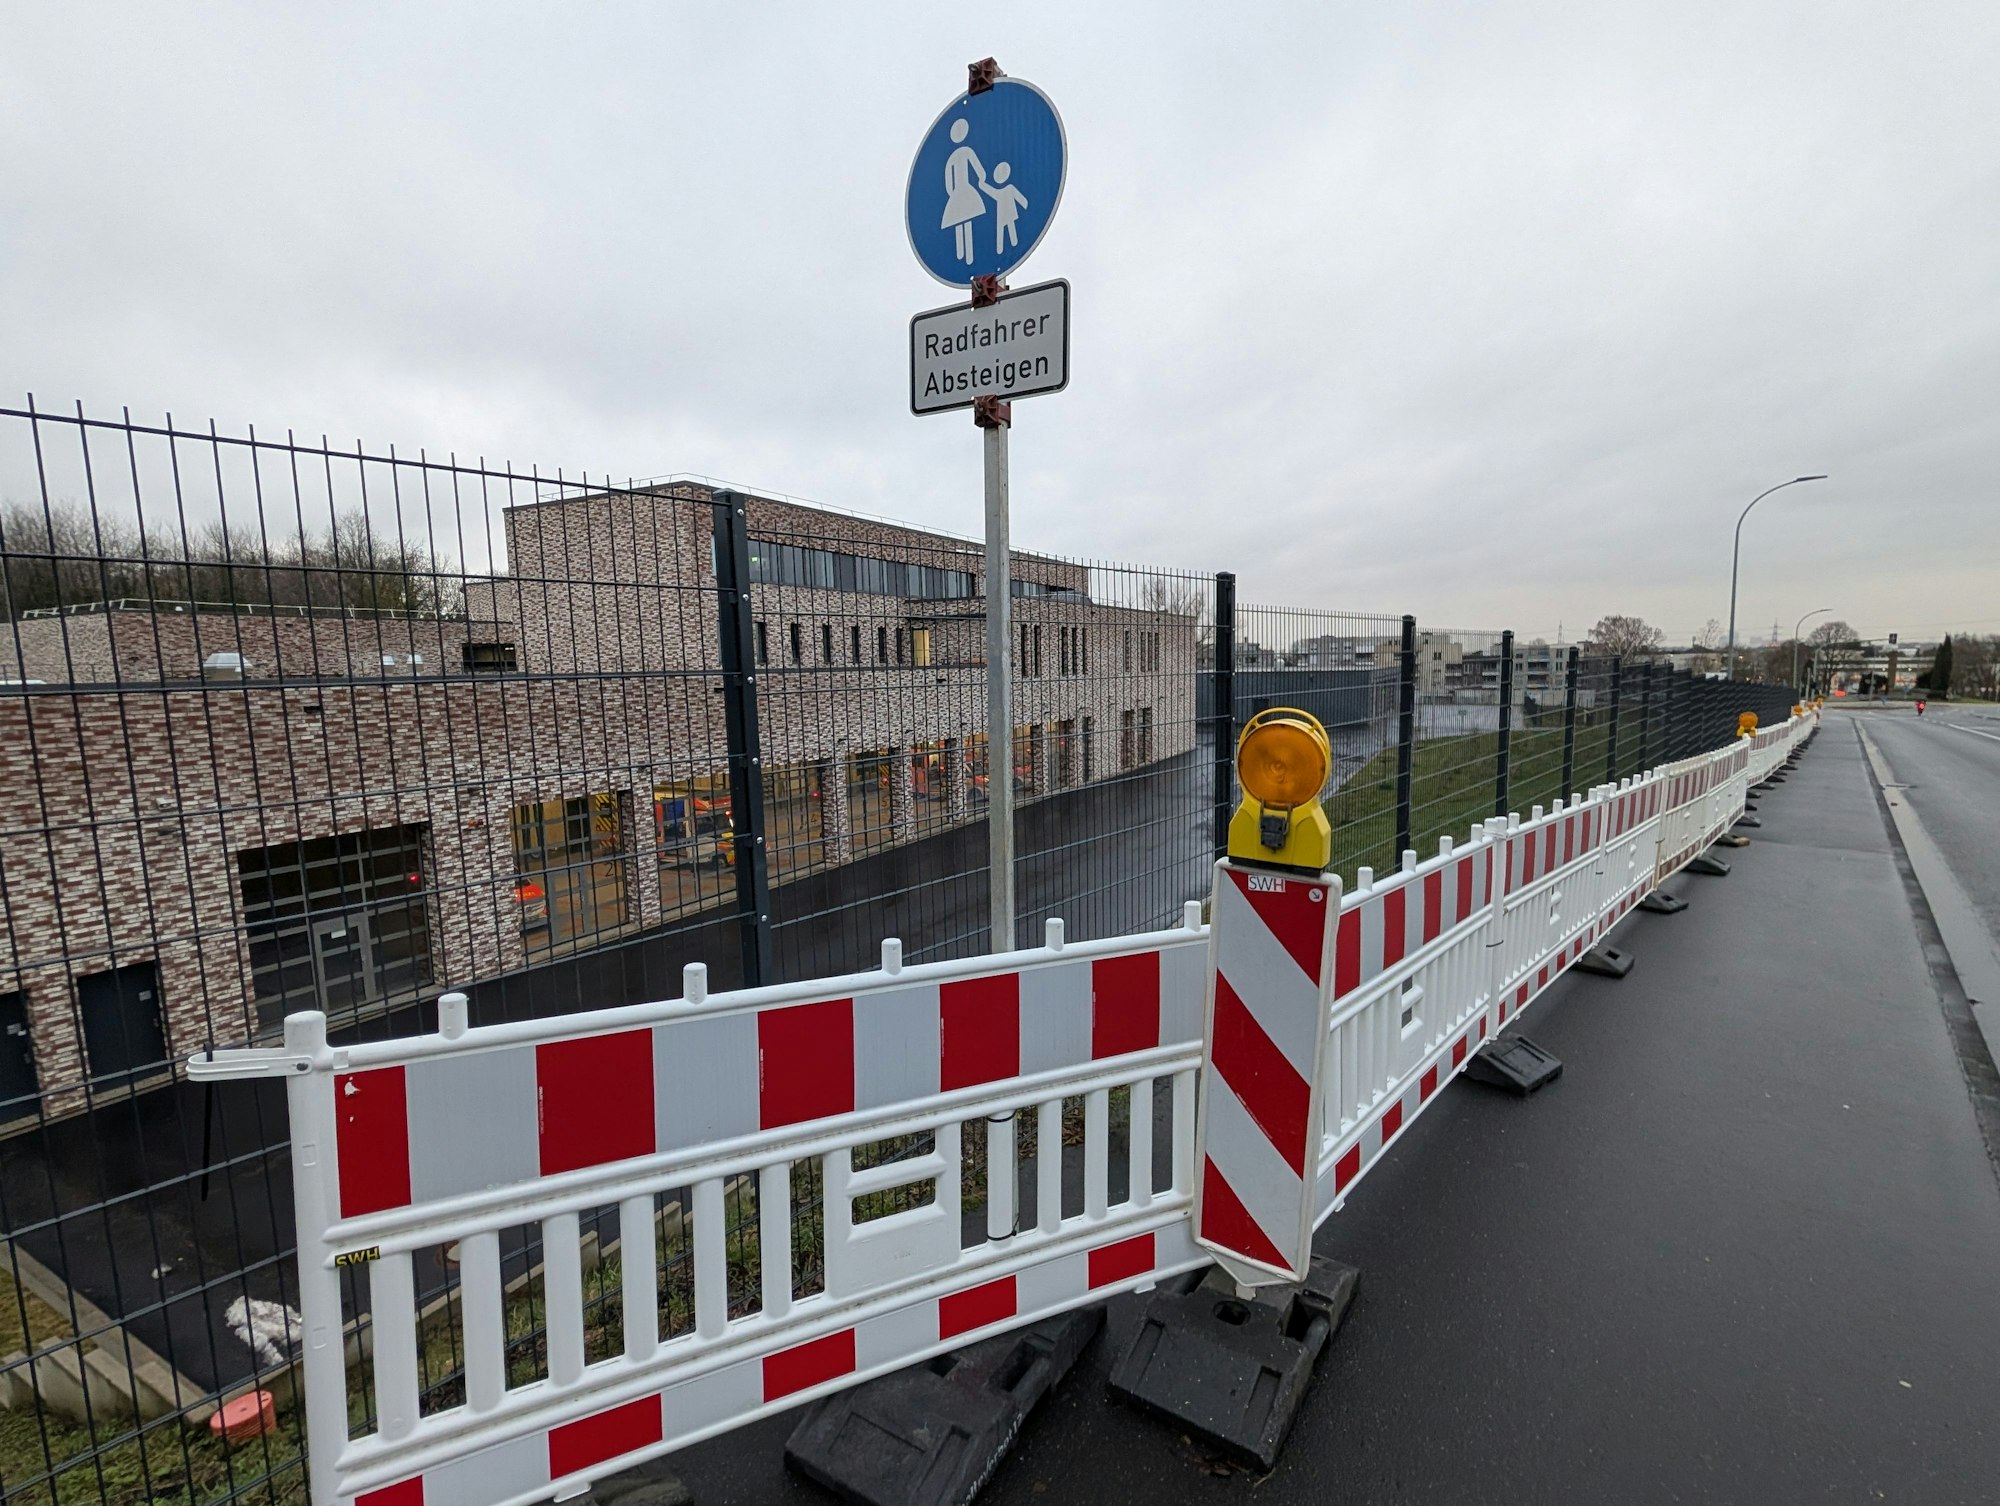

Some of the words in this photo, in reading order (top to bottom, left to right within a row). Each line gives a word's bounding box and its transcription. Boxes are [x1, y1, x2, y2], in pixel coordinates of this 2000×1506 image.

[925, 314, 1050, 359] Radfahrer
[924, 355, 1048, 397] Absteigen
[1249, 876, 1285, 892] SWH
[336, 1247, 379, 1267] SWH
